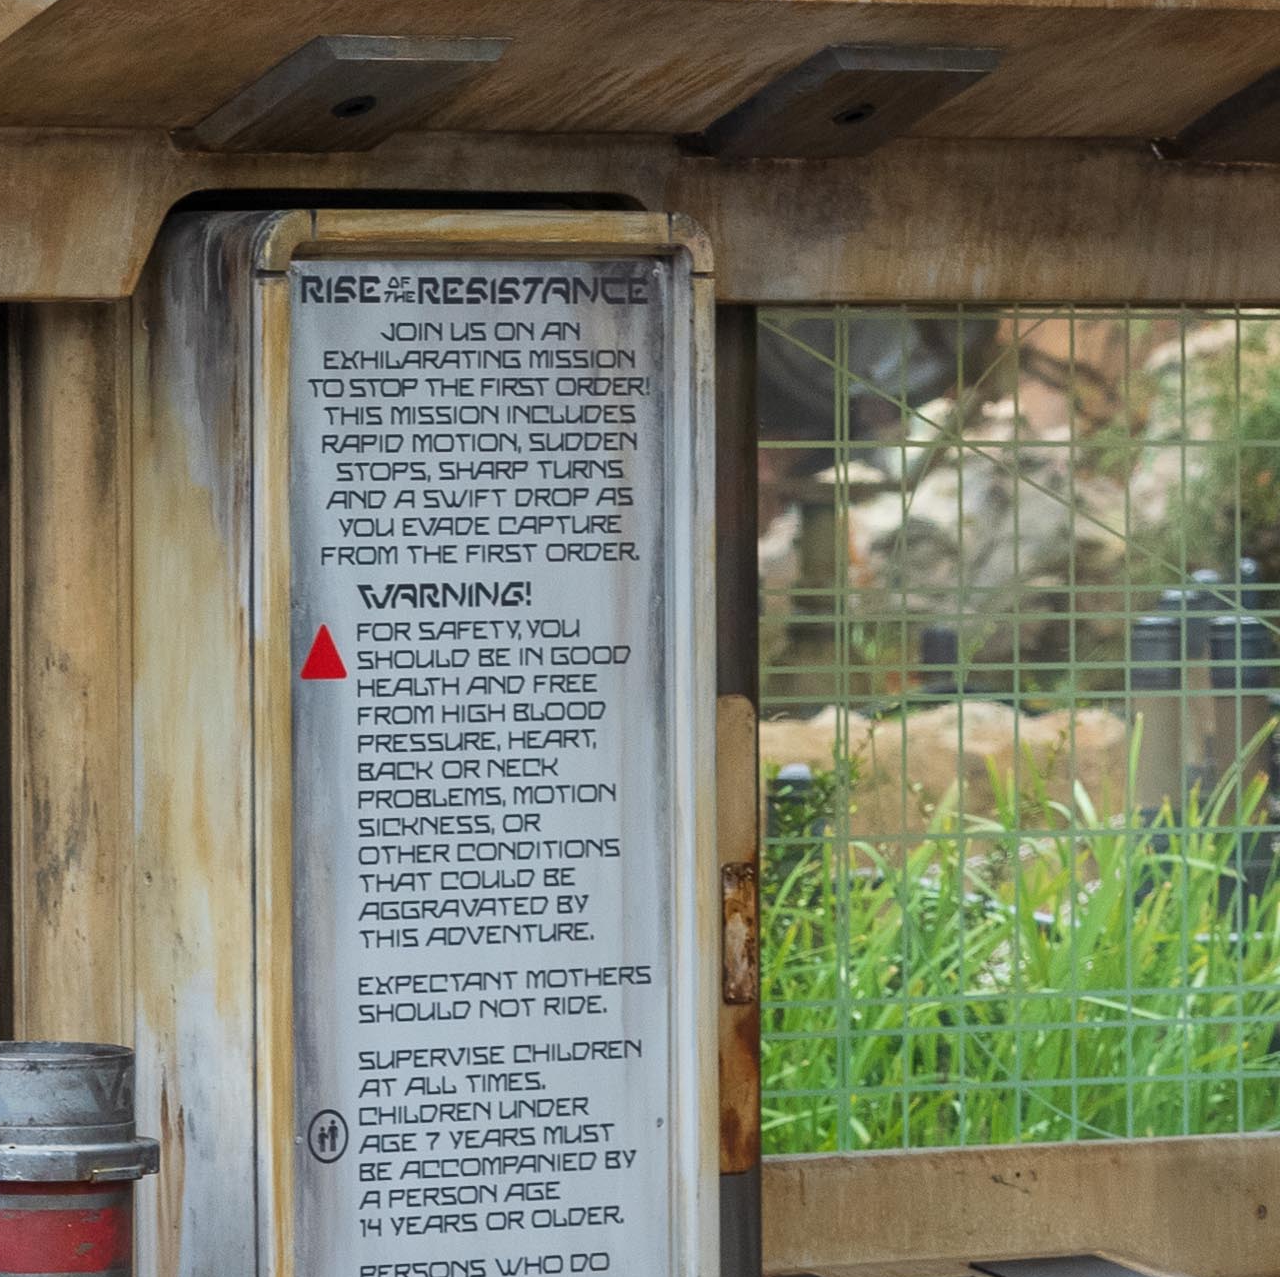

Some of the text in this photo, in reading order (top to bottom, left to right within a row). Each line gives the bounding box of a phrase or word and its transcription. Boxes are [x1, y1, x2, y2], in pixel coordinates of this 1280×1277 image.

[300, 274, 649, 305] RISE OF THE RESISTANCE
[380, 322, 580, 342] JOIN US ON AN
[323, 349, 635, 371] EXHILARATING MISSION
[307, 376, 650, 398] TO STOP THE FIRST ORDER!
[323, 404, 636, 426] THIS MISSION INCLUDES
[321, 432, 638, 454] RAPID MOTION, SUDDEN
[336, 459, 625, 483] STOPS, SHARP TURNS
[326, 487, 634, 510] AND A SWIFT DROP AS
[338, 514, 622, 538] YOU EVADE CAPTURE
[321, 542, 640, 566] FROM THE FIRST ORDER.
[356, 581, 532, 610] WARNING!
[356, 619, 580, 642] FOR SAFETY, YOU
[357, 645, 631, 670] SHOULD BE IN GOOD
[357, 673, 598, 698] HEALTH AND FREE
[357, 701, 606, 726] FROM HIGH BLOOD
[357, 728, 597, 754] PRESSURE, HEART,
[358, 757, 559, 782] BACK OR NECK
[358, 783, 616, 809] PROBLEMS, MOTION
[358, 813, 541, 838] SICKNESS, OR
[358, 838, 621, 866] OTHER CONDITIONS
[358, 867, 576, 893] THAT COULD BE
[358, 894, 589, 922] AGGRAVATED BY
[358, 922, 594, 949] THIS ADVENTURE.
[358, 965, 652, 996] EXPECTANT MOTHERS
[358, 995, 607, 1024] SHOULD NOT RIDE.
[358, 1039, 642, 1071] SUPERVISE CHILDREN
[358, 1071, 546, 1099] AT ALL TIMES.
[358, 1096, 590, 1126] CHILDREN UNDER
[358, 1123, 615, 1154] AGE 7 YEARS MUST
[359, 1149, 637, 1182] BE ACCOMPANIED BY
[358, 1181, 561, 1210] A PERSON AGE
[359, 1205, 624, 1238] 14 YEARS OR OLDER.
[495, 1254, 564, 1277] WHO
[570, 1252, 610, 1273] DO
